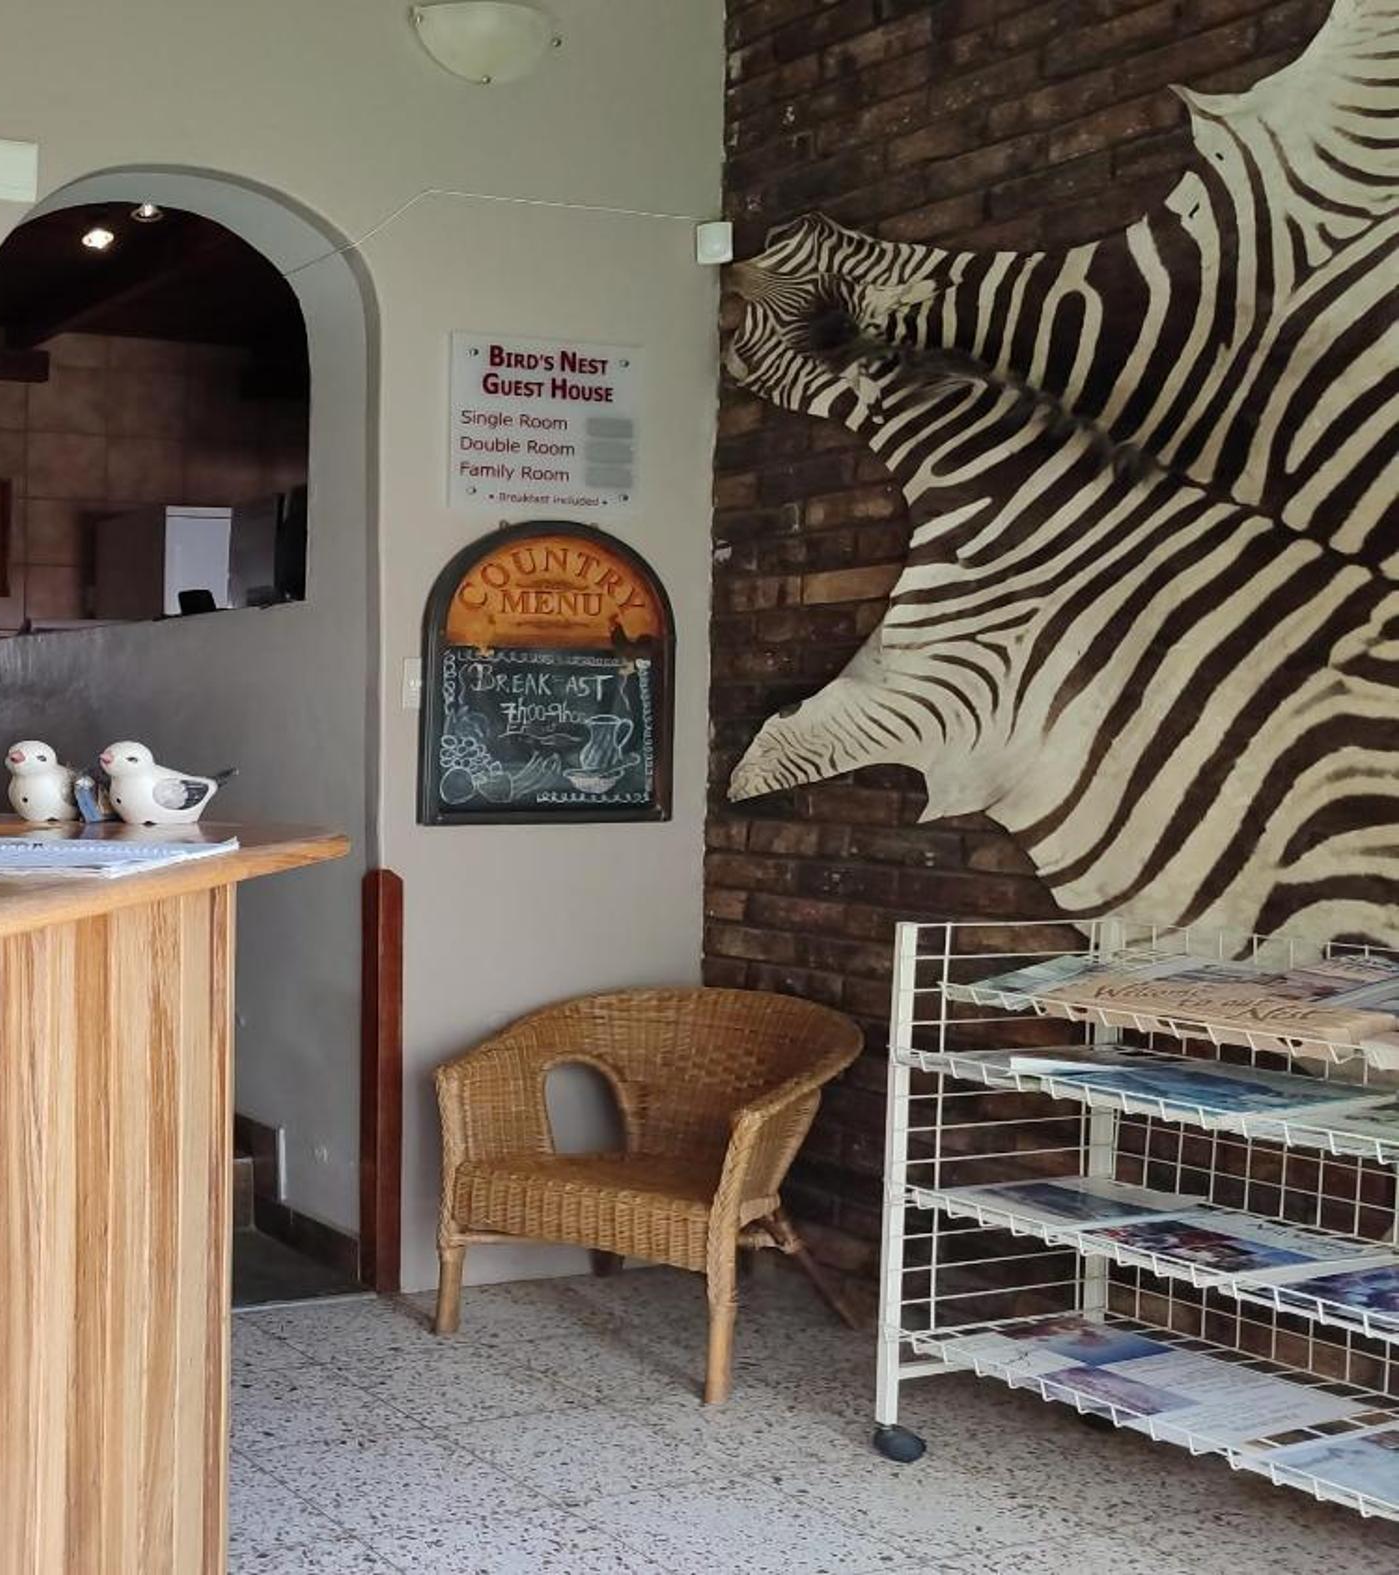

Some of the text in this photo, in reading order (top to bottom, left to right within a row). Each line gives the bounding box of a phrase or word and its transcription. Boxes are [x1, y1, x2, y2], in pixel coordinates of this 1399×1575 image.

[489, 345, 608, 375] BIRD'S NEST
[482, 373, 614, 403] GUEST HOUSE
[461, 410, 568, 430] Single Room
[460, 436, 575, 456] Double Room
[460, 461, 570, 482] Family Room
[459, 548, 645, 612] COUNTRY
[501, 589, 603, 616] MENU
